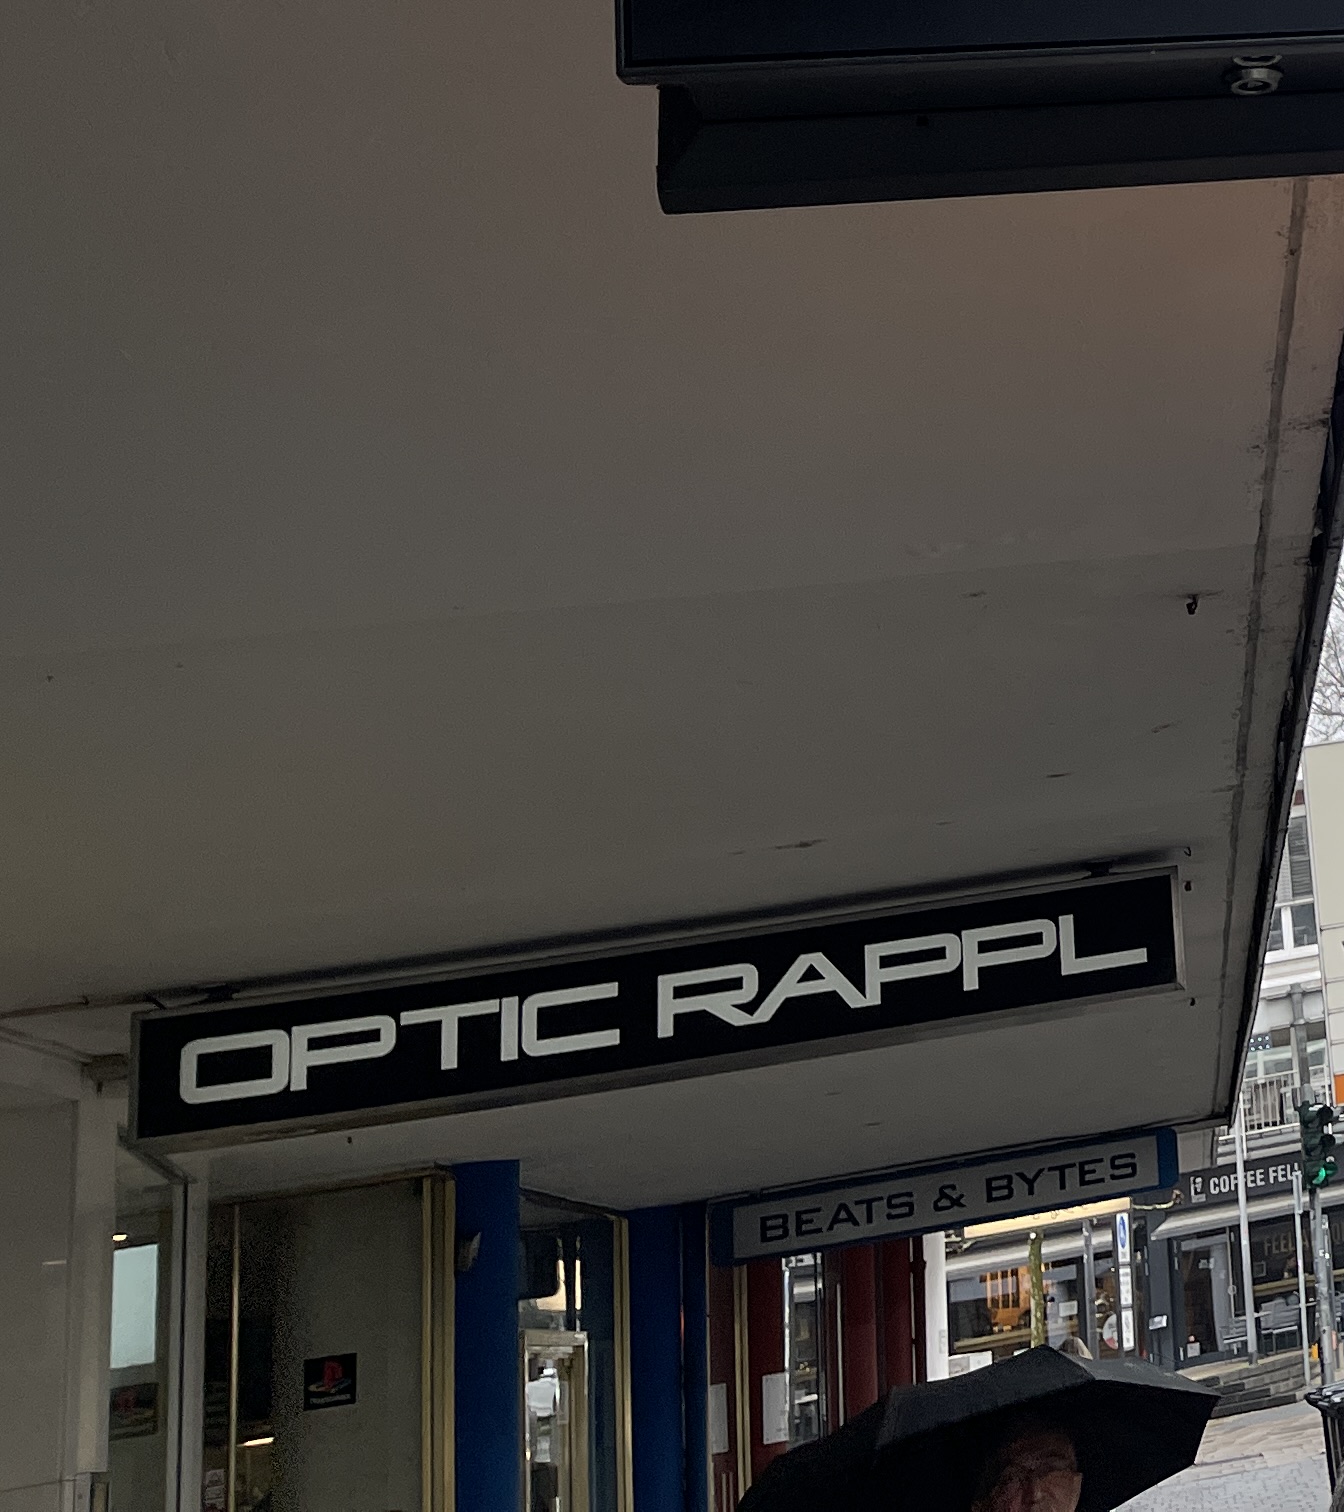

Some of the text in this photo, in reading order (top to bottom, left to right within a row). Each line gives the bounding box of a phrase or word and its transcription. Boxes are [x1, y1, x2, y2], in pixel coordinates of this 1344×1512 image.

[180, 914, 1148, 1105] OPTIC RAPPL
[760, 1152, 1138, 1243] BEATS & BYTES
[1209, 1168, 1266, 1195] COFEE
